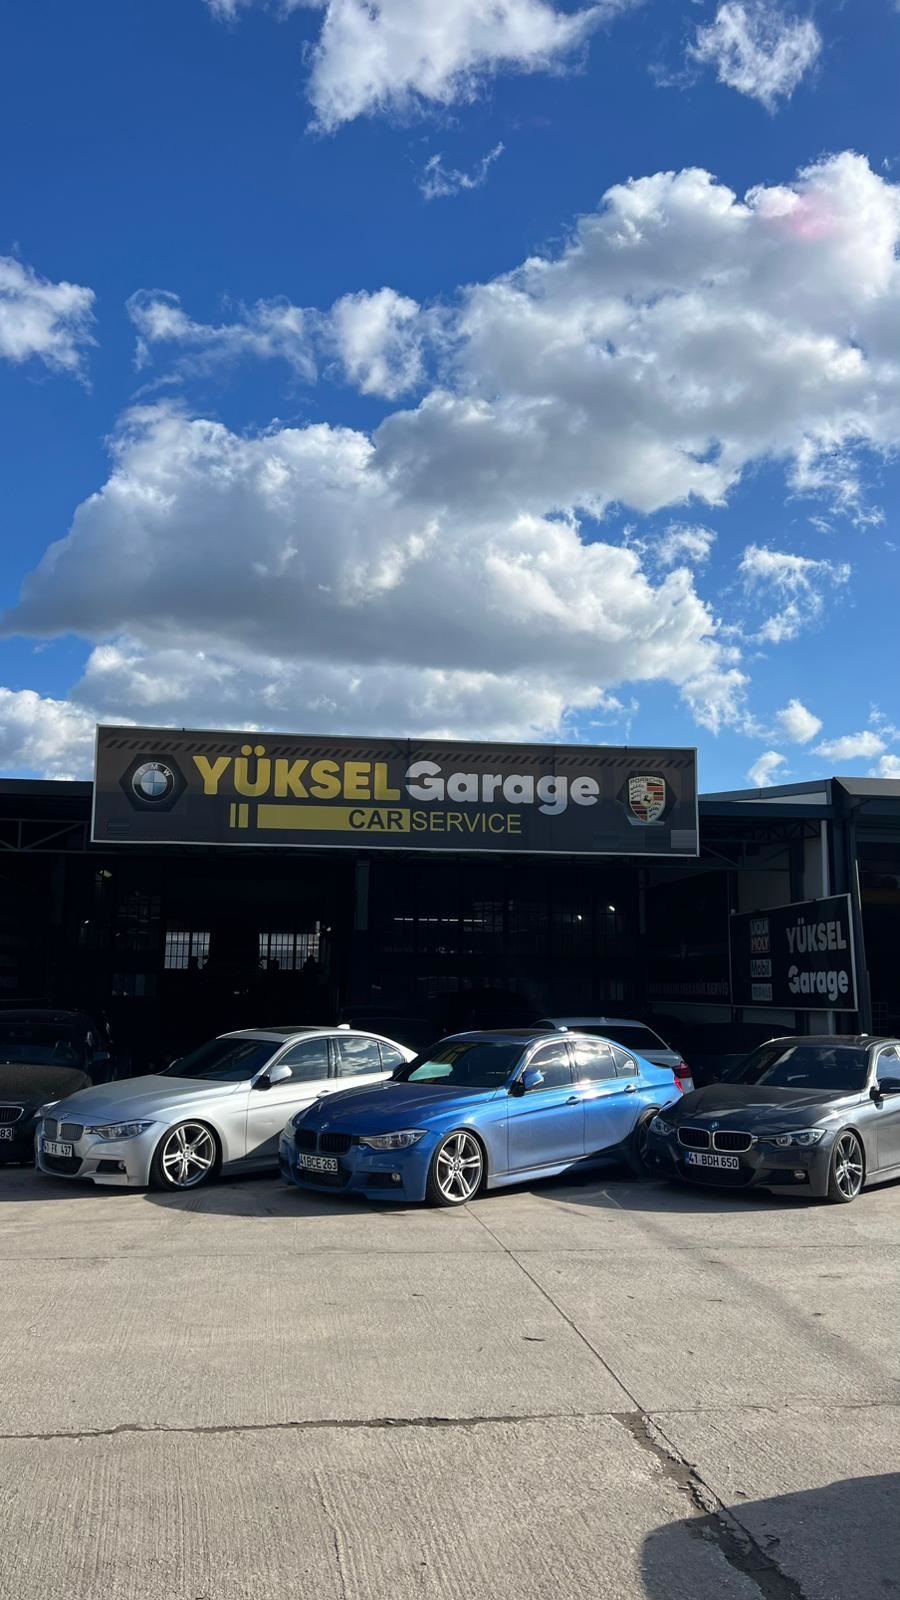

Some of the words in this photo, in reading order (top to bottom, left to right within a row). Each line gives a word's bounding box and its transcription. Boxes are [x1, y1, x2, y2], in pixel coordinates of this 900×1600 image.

[192, 744, 402, 801] YÜKSEL
[404, 760, 600, 816] Garage
[348, 809, 404, 831] CAR
[411, 811, 522, 834] SERVICE
[786, 917, 847, 954] YÜKSEL
[787, 965, 849, 1001] Garage
[689, 1154, 698, 1164] 41
[702, 1155, 719, 1166] BDH
[721, 1157, 738, 1168] 650
